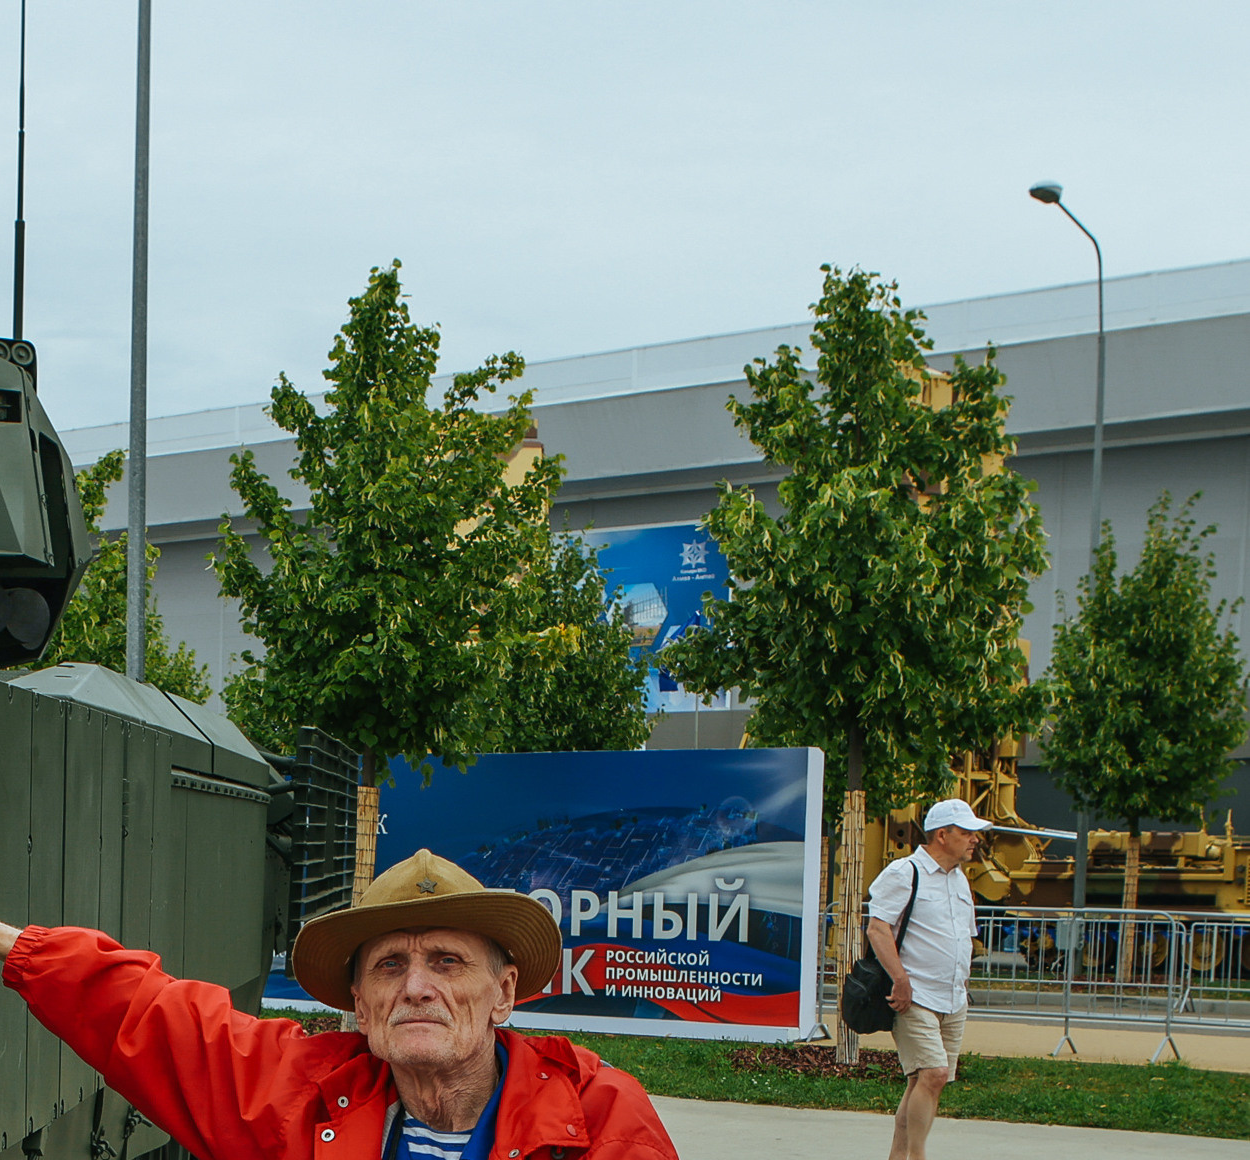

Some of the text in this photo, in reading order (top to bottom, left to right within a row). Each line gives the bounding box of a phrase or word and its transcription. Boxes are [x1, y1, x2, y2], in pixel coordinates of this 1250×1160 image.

[485, 878, 750, 943] ОРНЫЙ
[605, 948, 710, 967] РОССИЙСКОЙ
[605, 966, 763, 987] ПРОМЫШЛЕННОСТИ
[605, 984, 722, 1004] И ИННОВАЦИЙ
